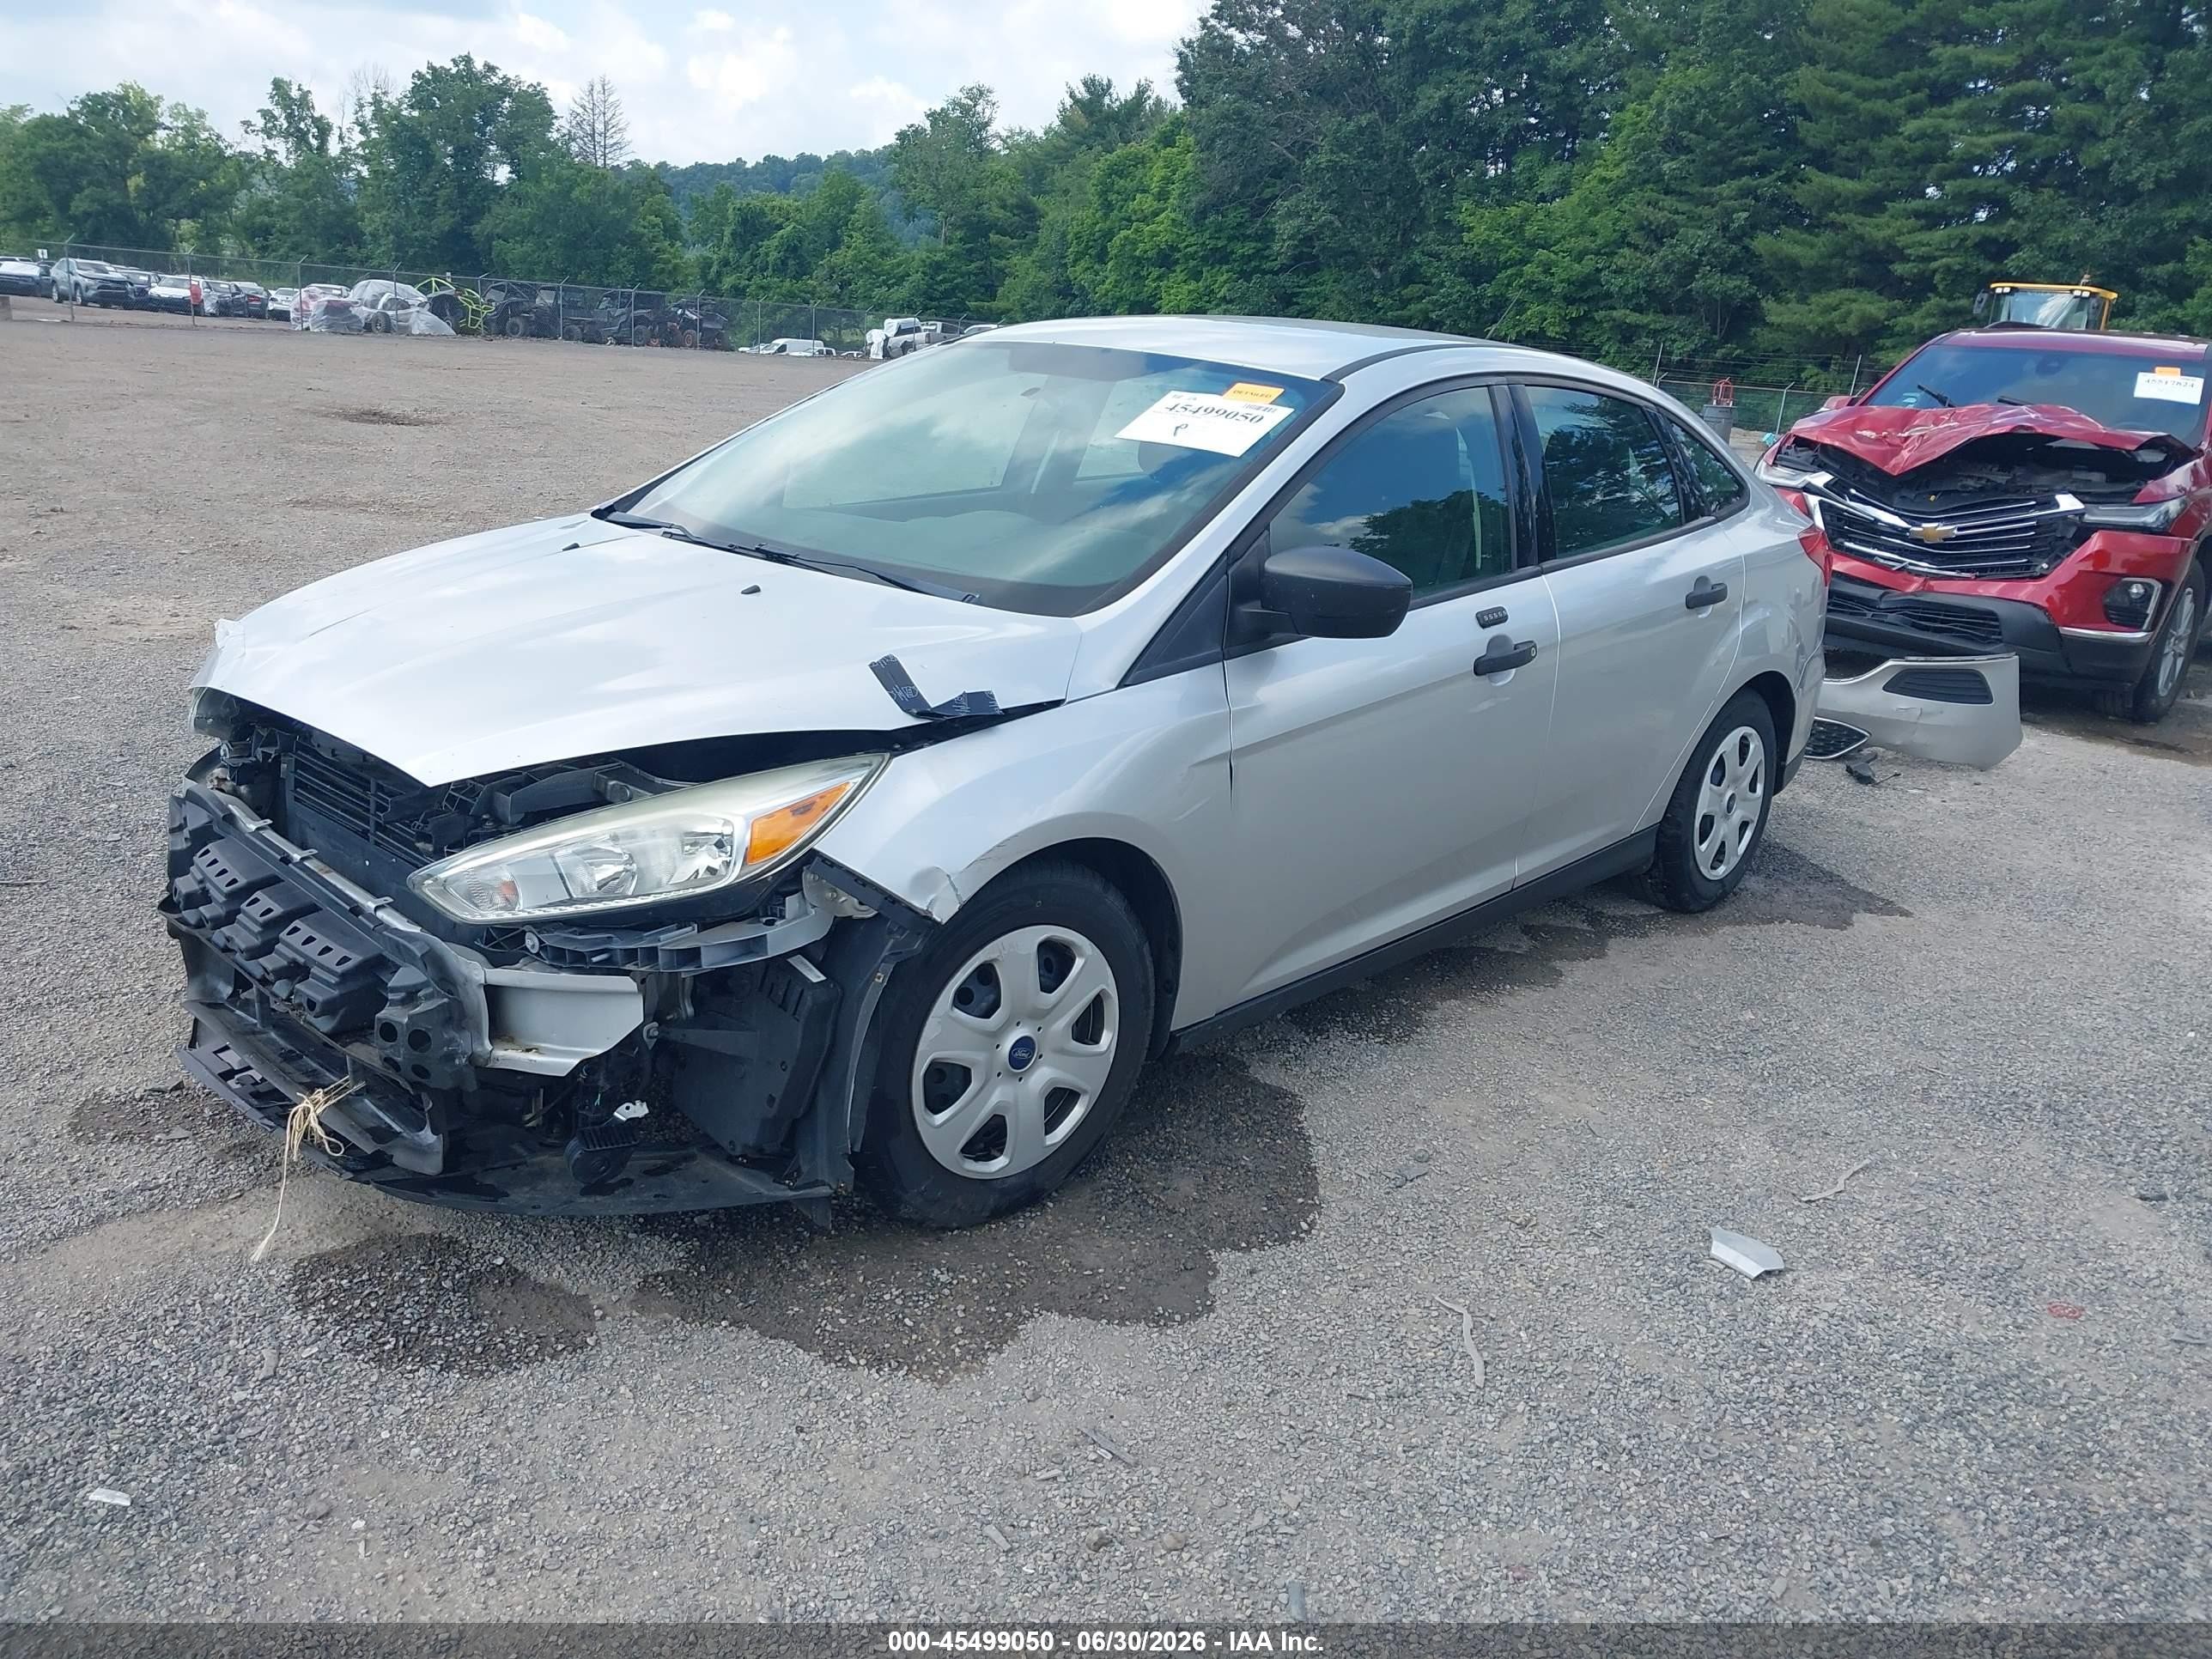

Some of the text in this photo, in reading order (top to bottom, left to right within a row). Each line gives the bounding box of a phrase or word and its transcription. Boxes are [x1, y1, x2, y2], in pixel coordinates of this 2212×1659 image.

[1232, 389, 1273, 398] DETAILED
[1164, 402, 1265, 424] 45499050
[1014, 1048, 1031, 1059] Ford
